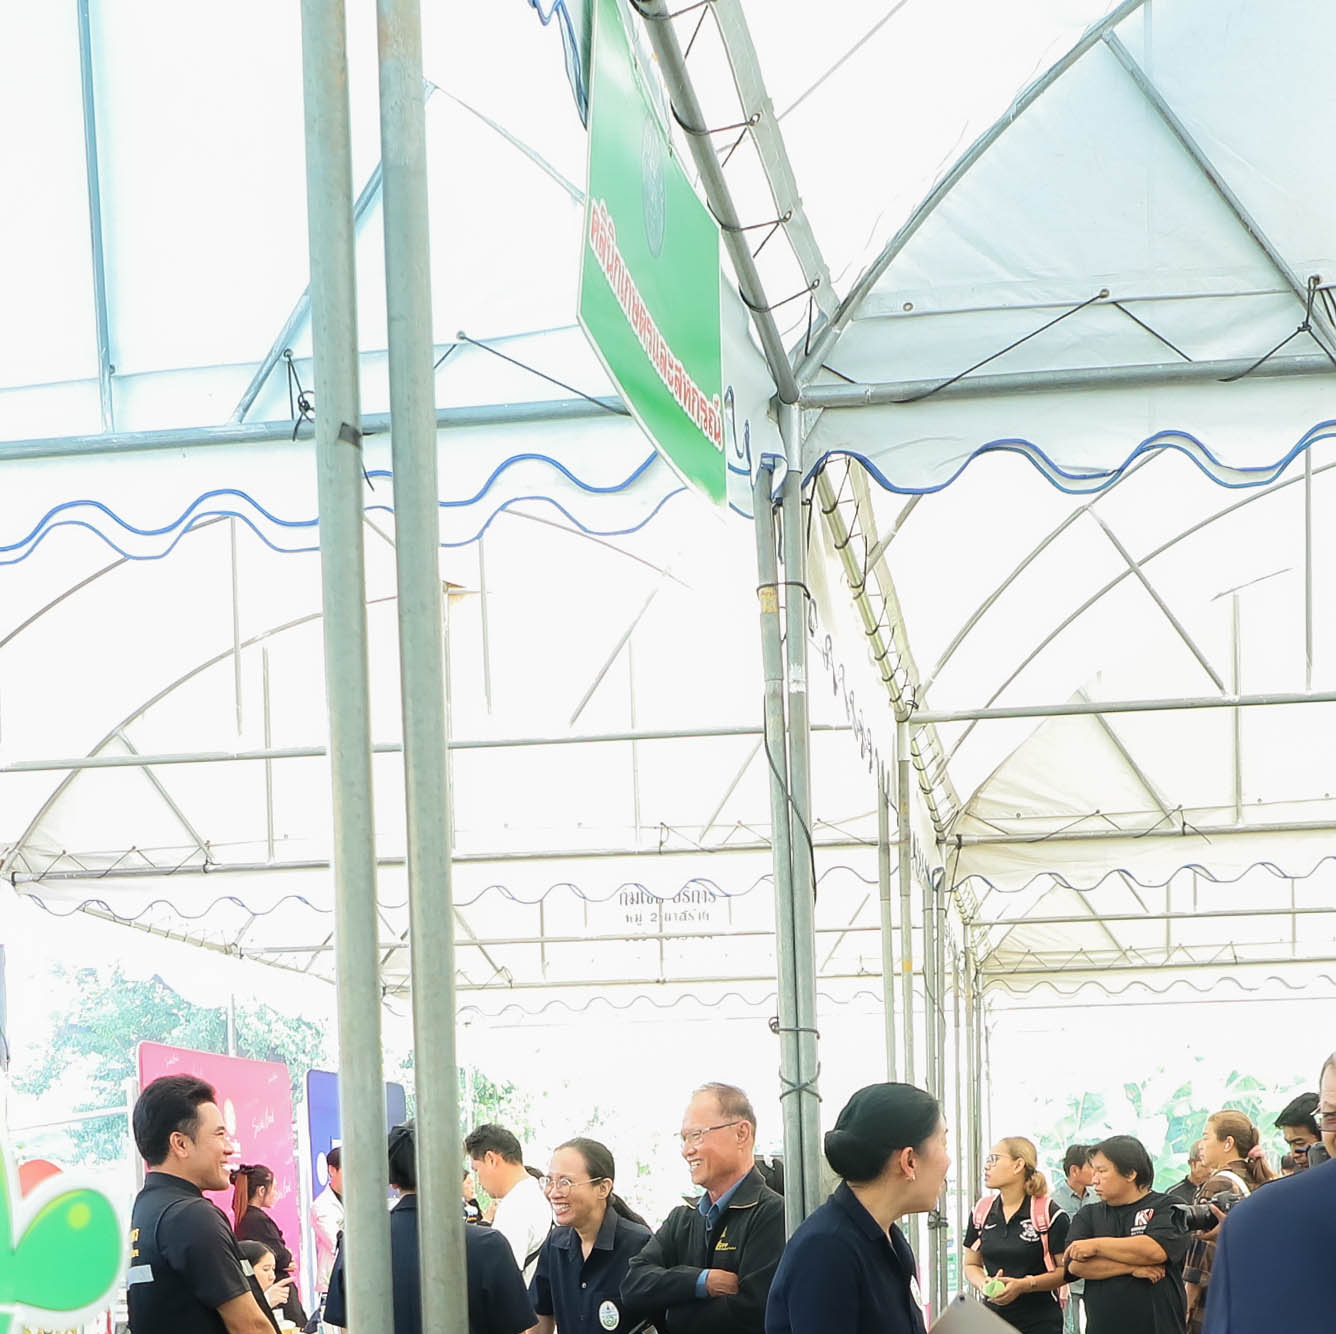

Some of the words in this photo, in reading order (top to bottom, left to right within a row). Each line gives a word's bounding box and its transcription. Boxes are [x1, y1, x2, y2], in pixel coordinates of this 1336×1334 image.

[590, 200, 723, 449] คลินิกเกษตรและสหกรณ์
